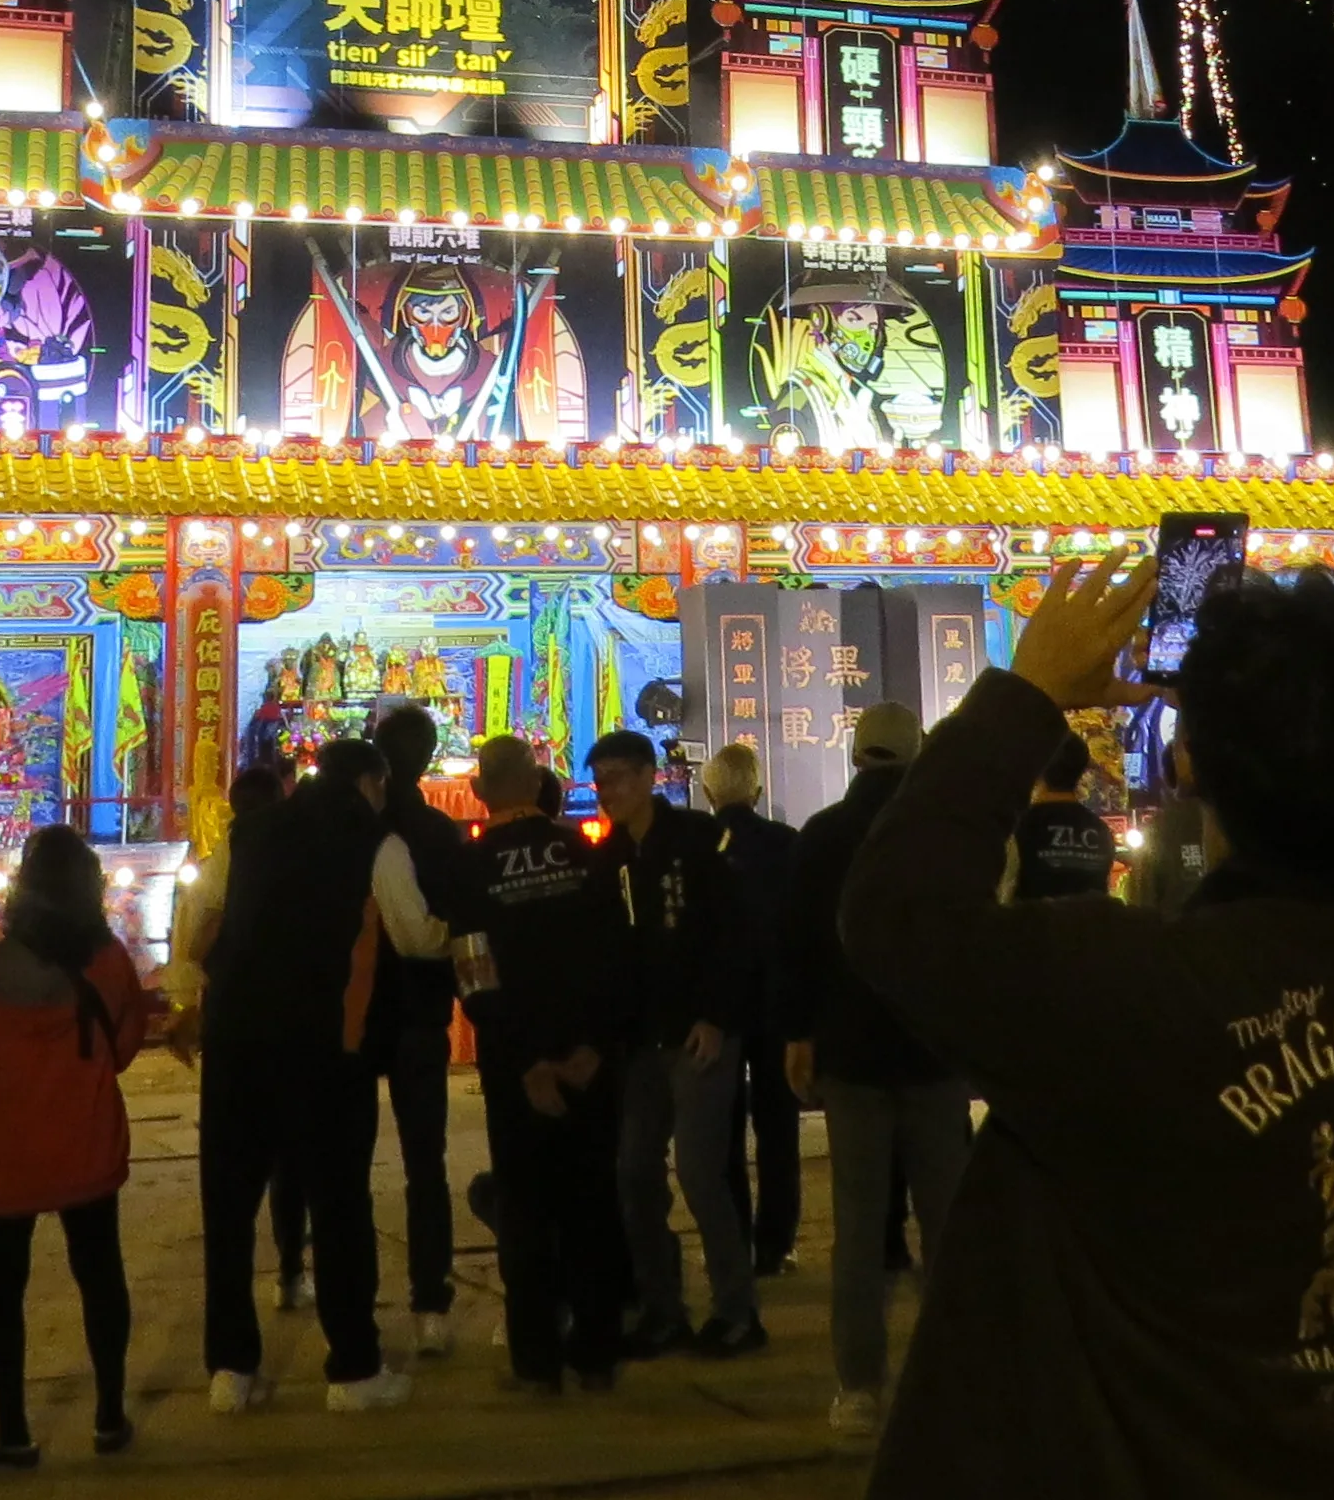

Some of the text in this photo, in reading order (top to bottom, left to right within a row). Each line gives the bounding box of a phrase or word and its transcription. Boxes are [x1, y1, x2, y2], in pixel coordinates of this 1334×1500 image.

[389, 227, 480, 249] 靚靚六堆
[1047, 825, 1099, 849] ZLC
[496, 840, 570, 877] ZLC
